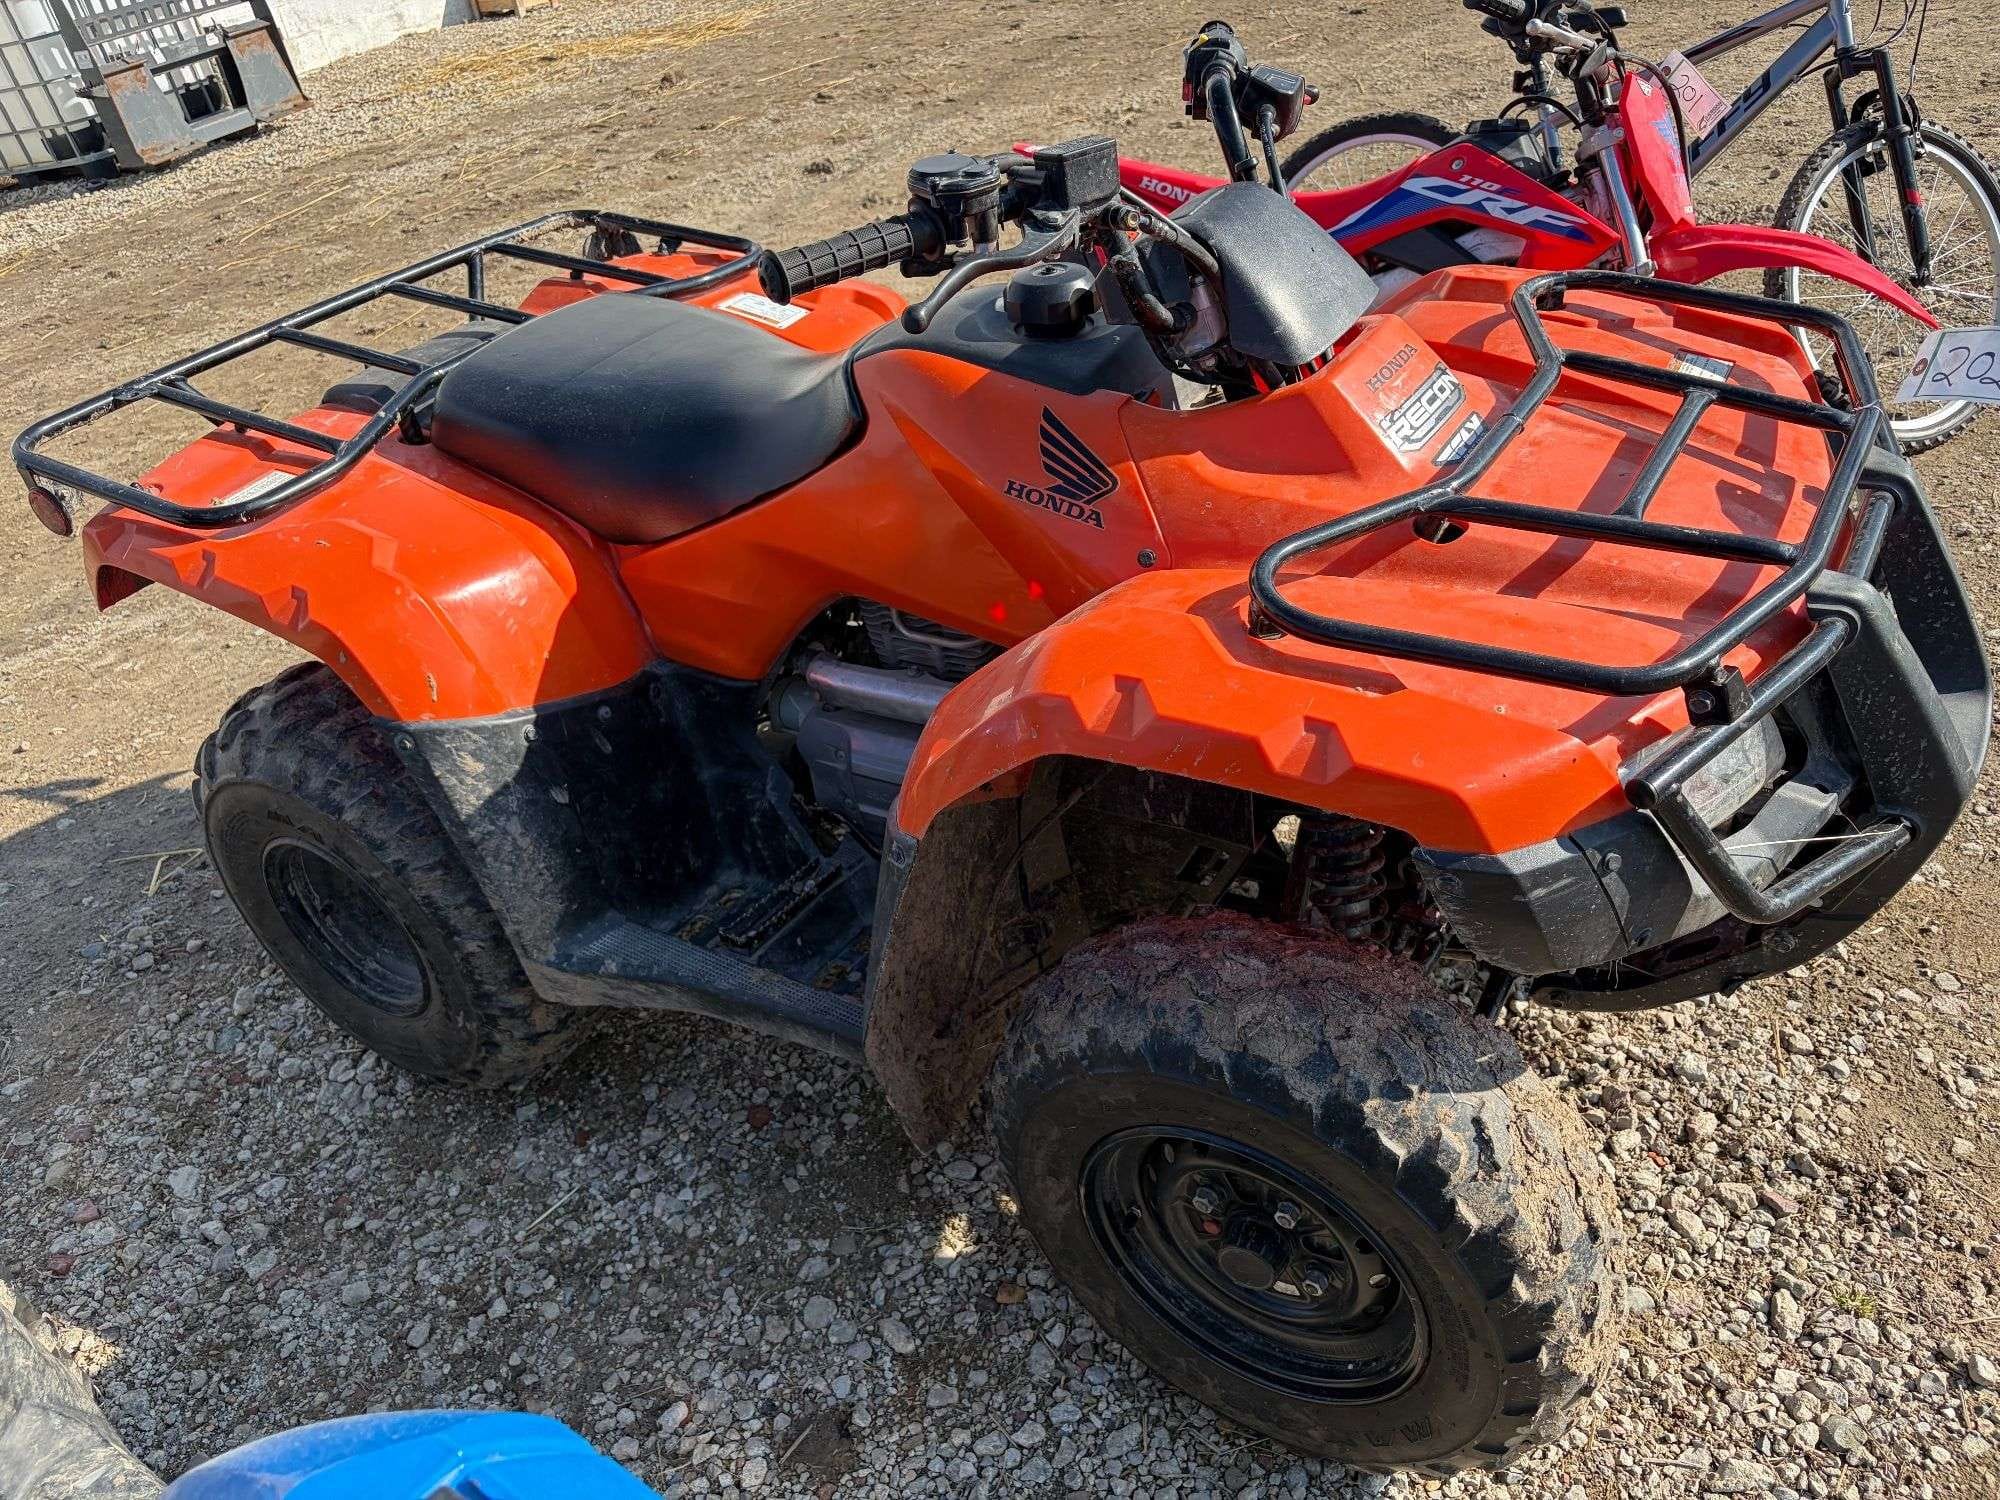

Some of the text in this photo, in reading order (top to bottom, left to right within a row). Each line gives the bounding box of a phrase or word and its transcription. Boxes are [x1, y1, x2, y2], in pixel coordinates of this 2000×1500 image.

[1668, 74, 1703, 113] 201
[1139, 175, 1200, 202] HON
[1400, 176, 1590, 227] CRF
[1366, 343, 1418, 393] HONDA
[1388, 373, 1460, 450] RECON
[1003, 479, 1105, 530] HONDA
